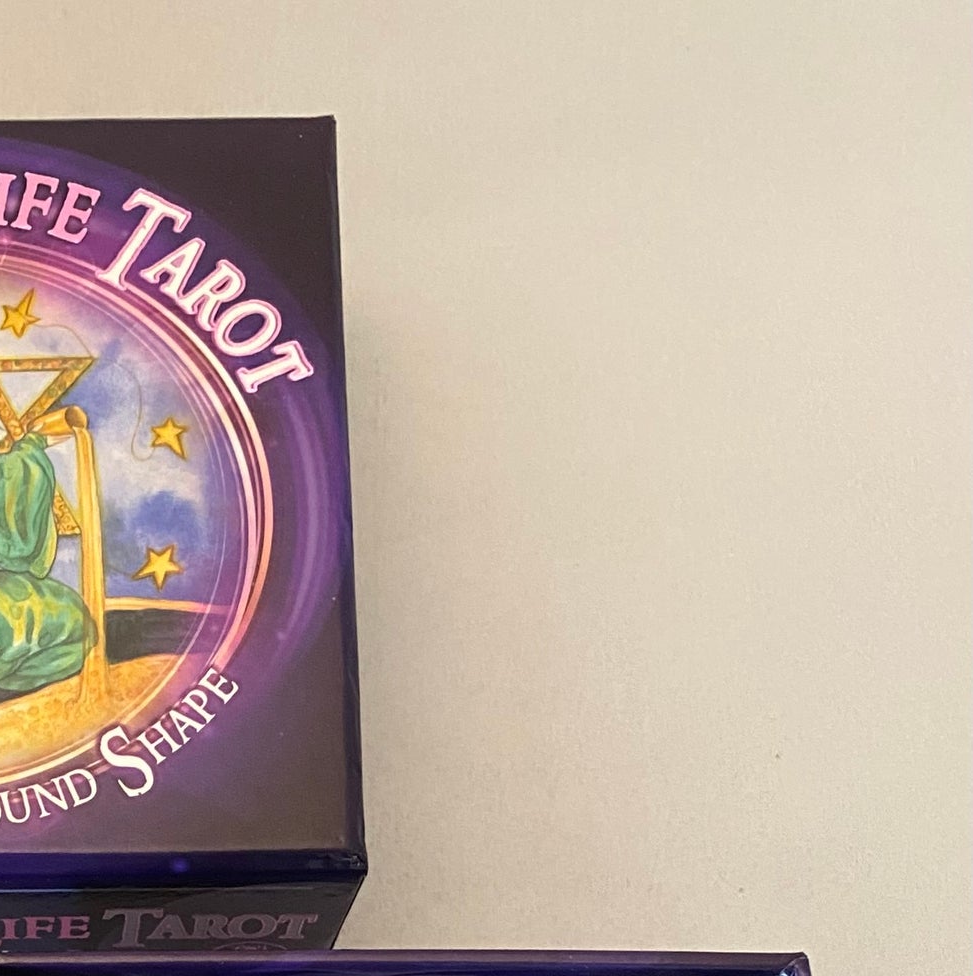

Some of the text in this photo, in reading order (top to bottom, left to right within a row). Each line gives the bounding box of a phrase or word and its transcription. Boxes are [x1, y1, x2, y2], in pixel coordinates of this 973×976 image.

[94, 187, 314, 396] TAROT
[98, 667, 239, 798] SHAPE
[102, 908, 319, 948] TAROT
